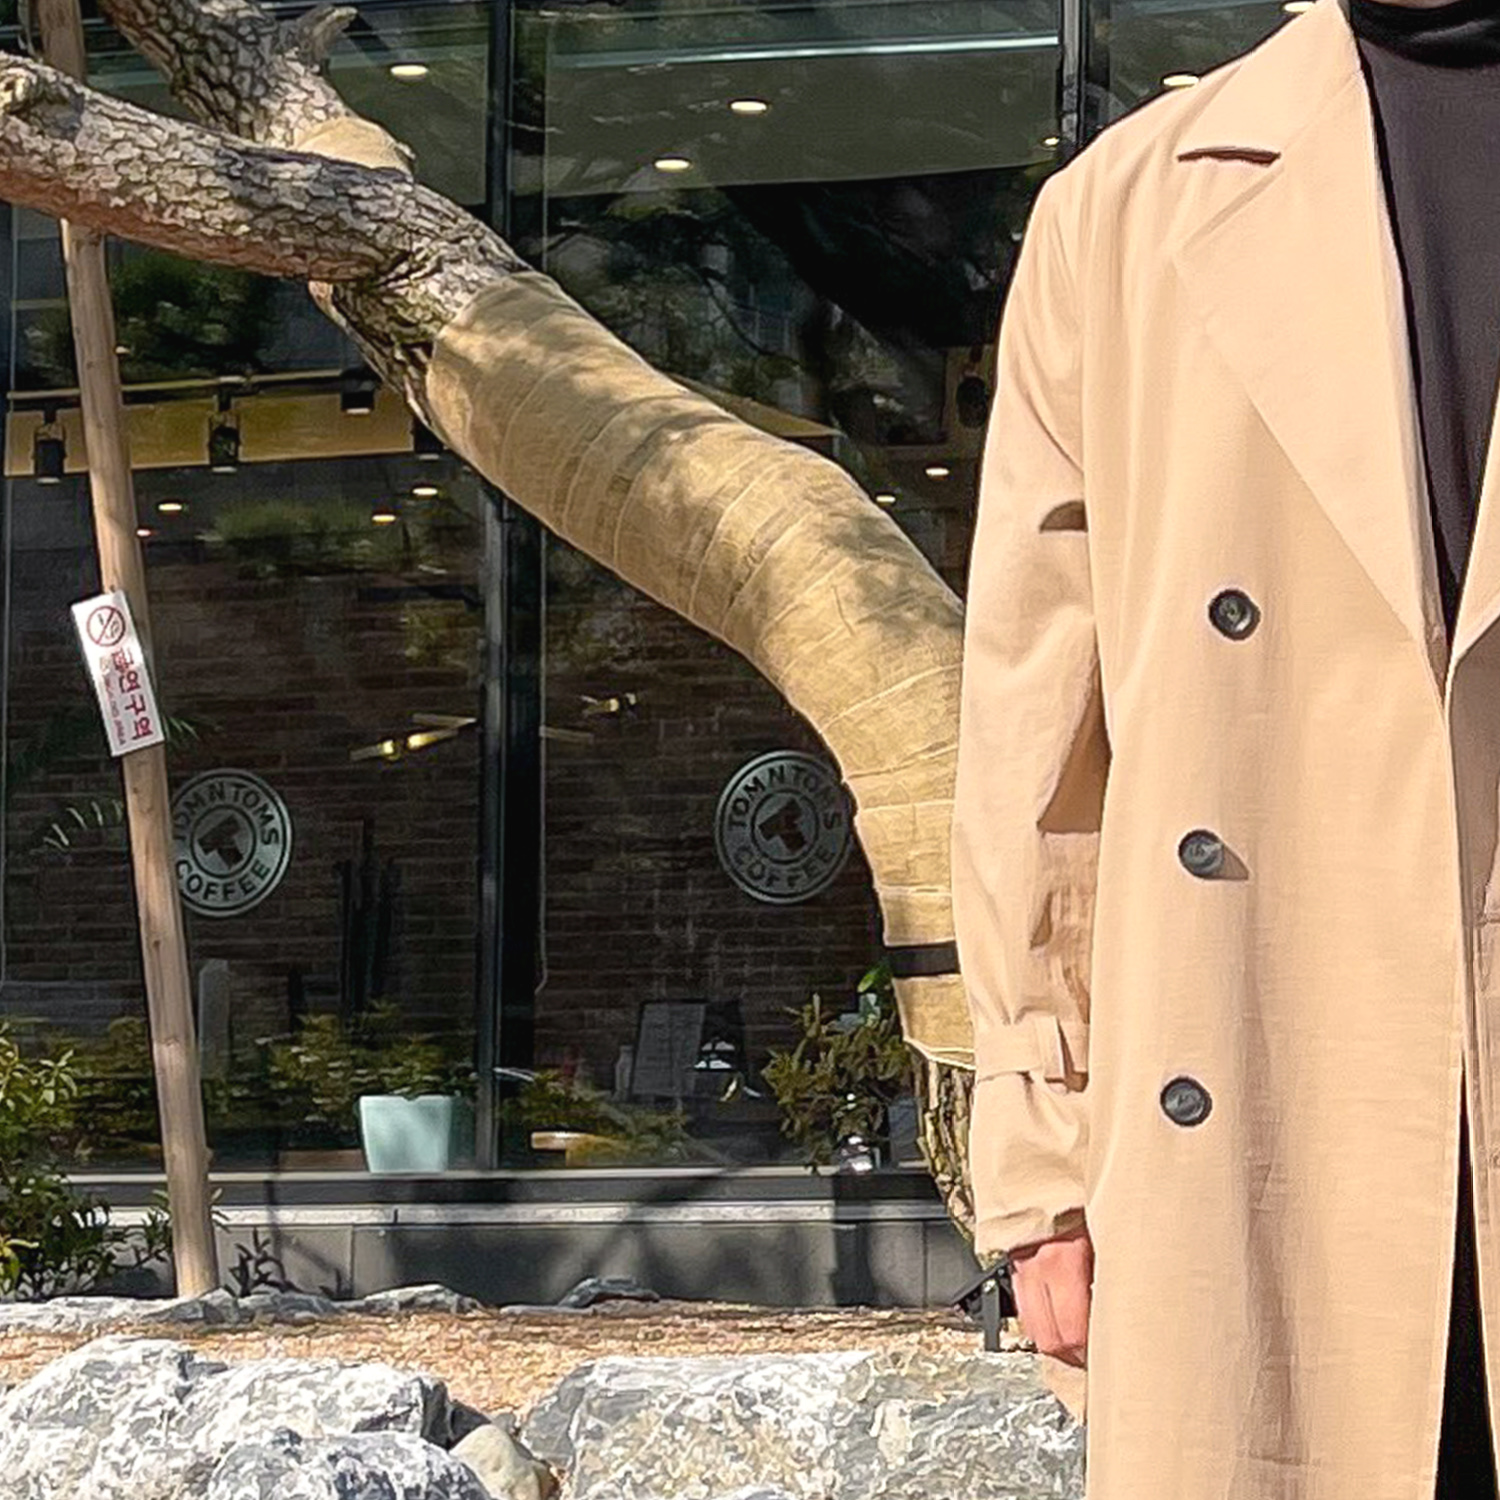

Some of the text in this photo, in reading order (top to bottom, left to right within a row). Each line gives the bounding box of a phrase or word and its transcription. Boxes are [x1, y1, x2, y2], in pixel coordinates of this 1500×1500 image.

[208, 781, 225, 801] N
[230, 781, 280, 847] TOMS
[730, 777, 766, 829] TOM
[768, 764, 785, 785] N
[175, 858, 271, 901] COFFEE
[733, 844, 835, 889] COFFEE
